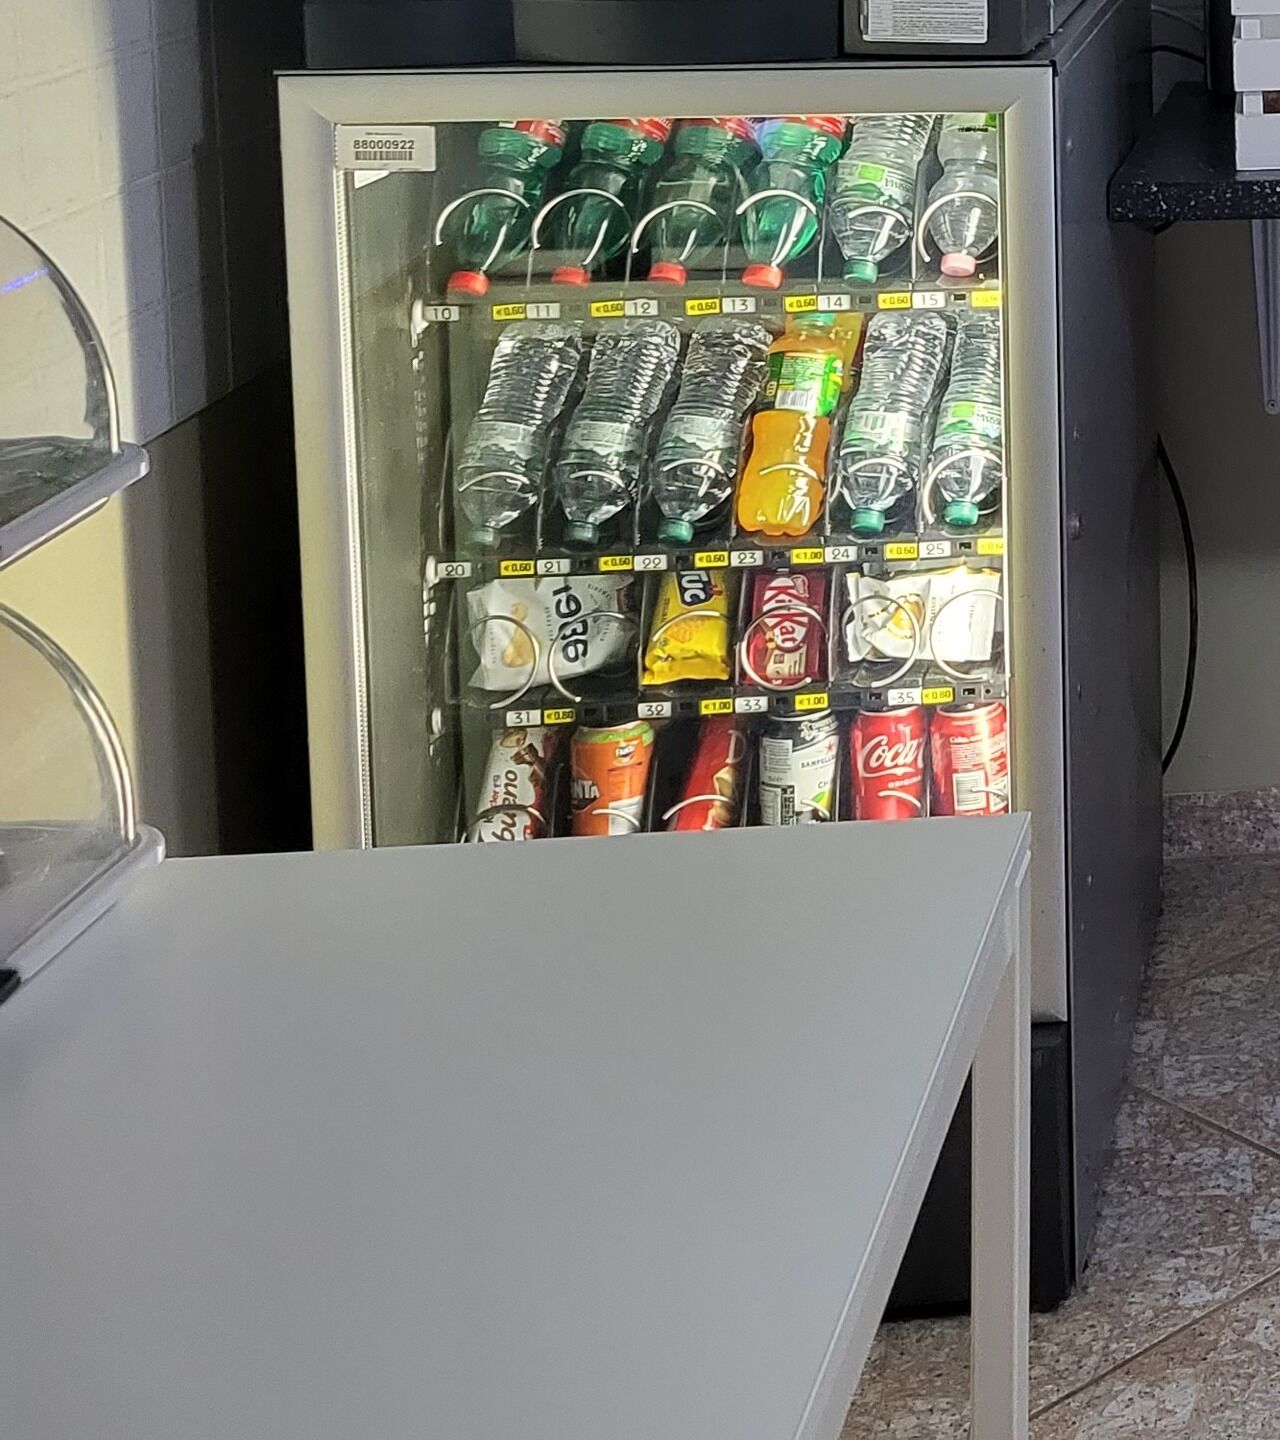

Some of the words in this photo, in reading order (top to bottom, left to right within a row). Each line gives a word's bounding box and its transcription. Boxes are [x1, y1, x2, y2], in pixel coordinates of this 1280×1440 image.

[353, 139, 415, 150] 88000922
[730, 299, 748, 311] 13
[826, 297, 843, 309] 14
[921, 294, 938, 306] 15
[434, 307, 451, 319] 10
[533, 304, 550, 317] 11
[633, 302, 651, 315] 12
[832, 548, 850, 560] 24
[926, 543, 945, 555] 25
[642, 557, 662, 569] 22
[737, 551, 756, 564] 23
[445, 564, 465, 576] 20
[544, 561, 561, 573] 21
[680, 570, 709, 602] TUC
[763, 585, 809, 645] KiKat
[645, 704, 664, 716] 32
[743, 698, 761, 710] 33
[514, 712, 530, 723] 31
[860, 723, 919, 778] Coca
[570, 779, 600, 799] NTA
[491, 769, 518, 841] bueno
